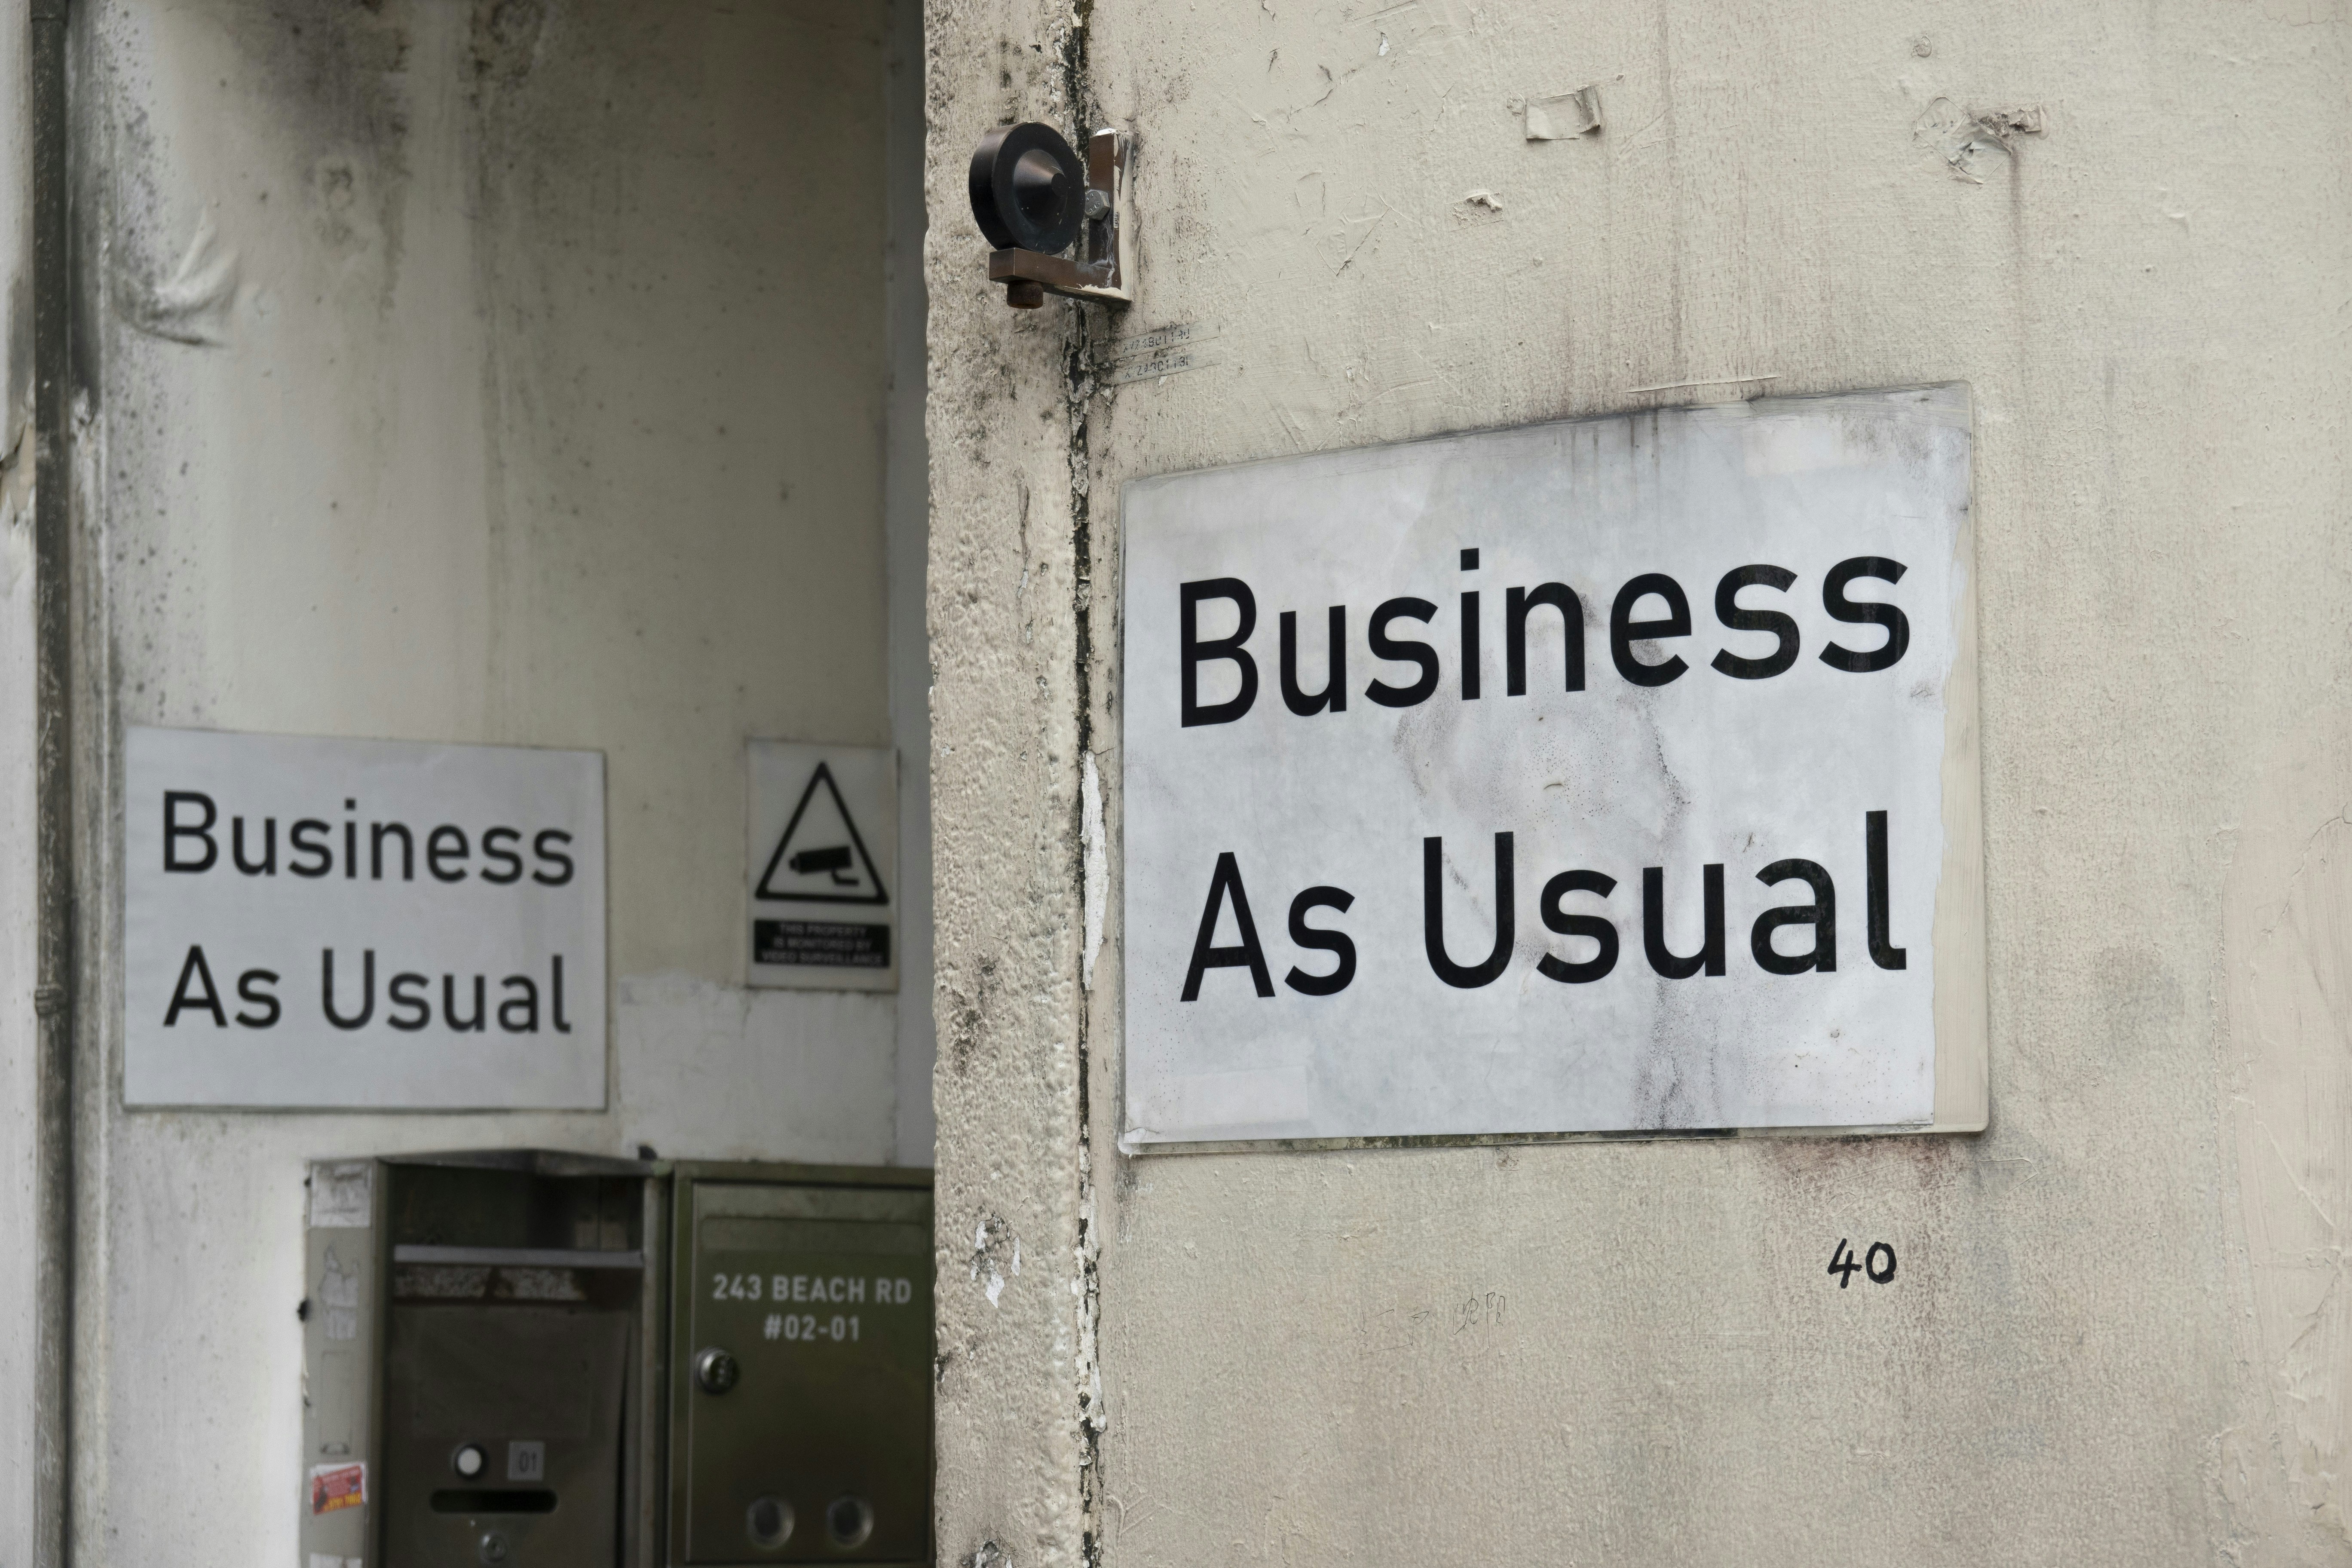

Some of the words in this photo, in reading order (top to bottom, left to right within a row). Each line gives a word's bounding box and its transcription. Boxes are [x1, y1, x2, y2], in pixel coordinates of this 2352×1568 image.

[1180, 548, 1909, 727] Business
[163, 790, 575, 887] Business
[1181, 852, 1357, 1001] As
[1424, 810, 1906, 989] Usual
[163, 944, 281, 1029] As
[322, 948, 572, 1034] Usual
[712, 1272, 763, 1302] 243
[770, 1274, 866, 1304] BEACH
[874, 1277, 912, 1305] RD
[1827, 1238, 1897, 1289] 40
[763, 1313, 860, 1342] #02-01
